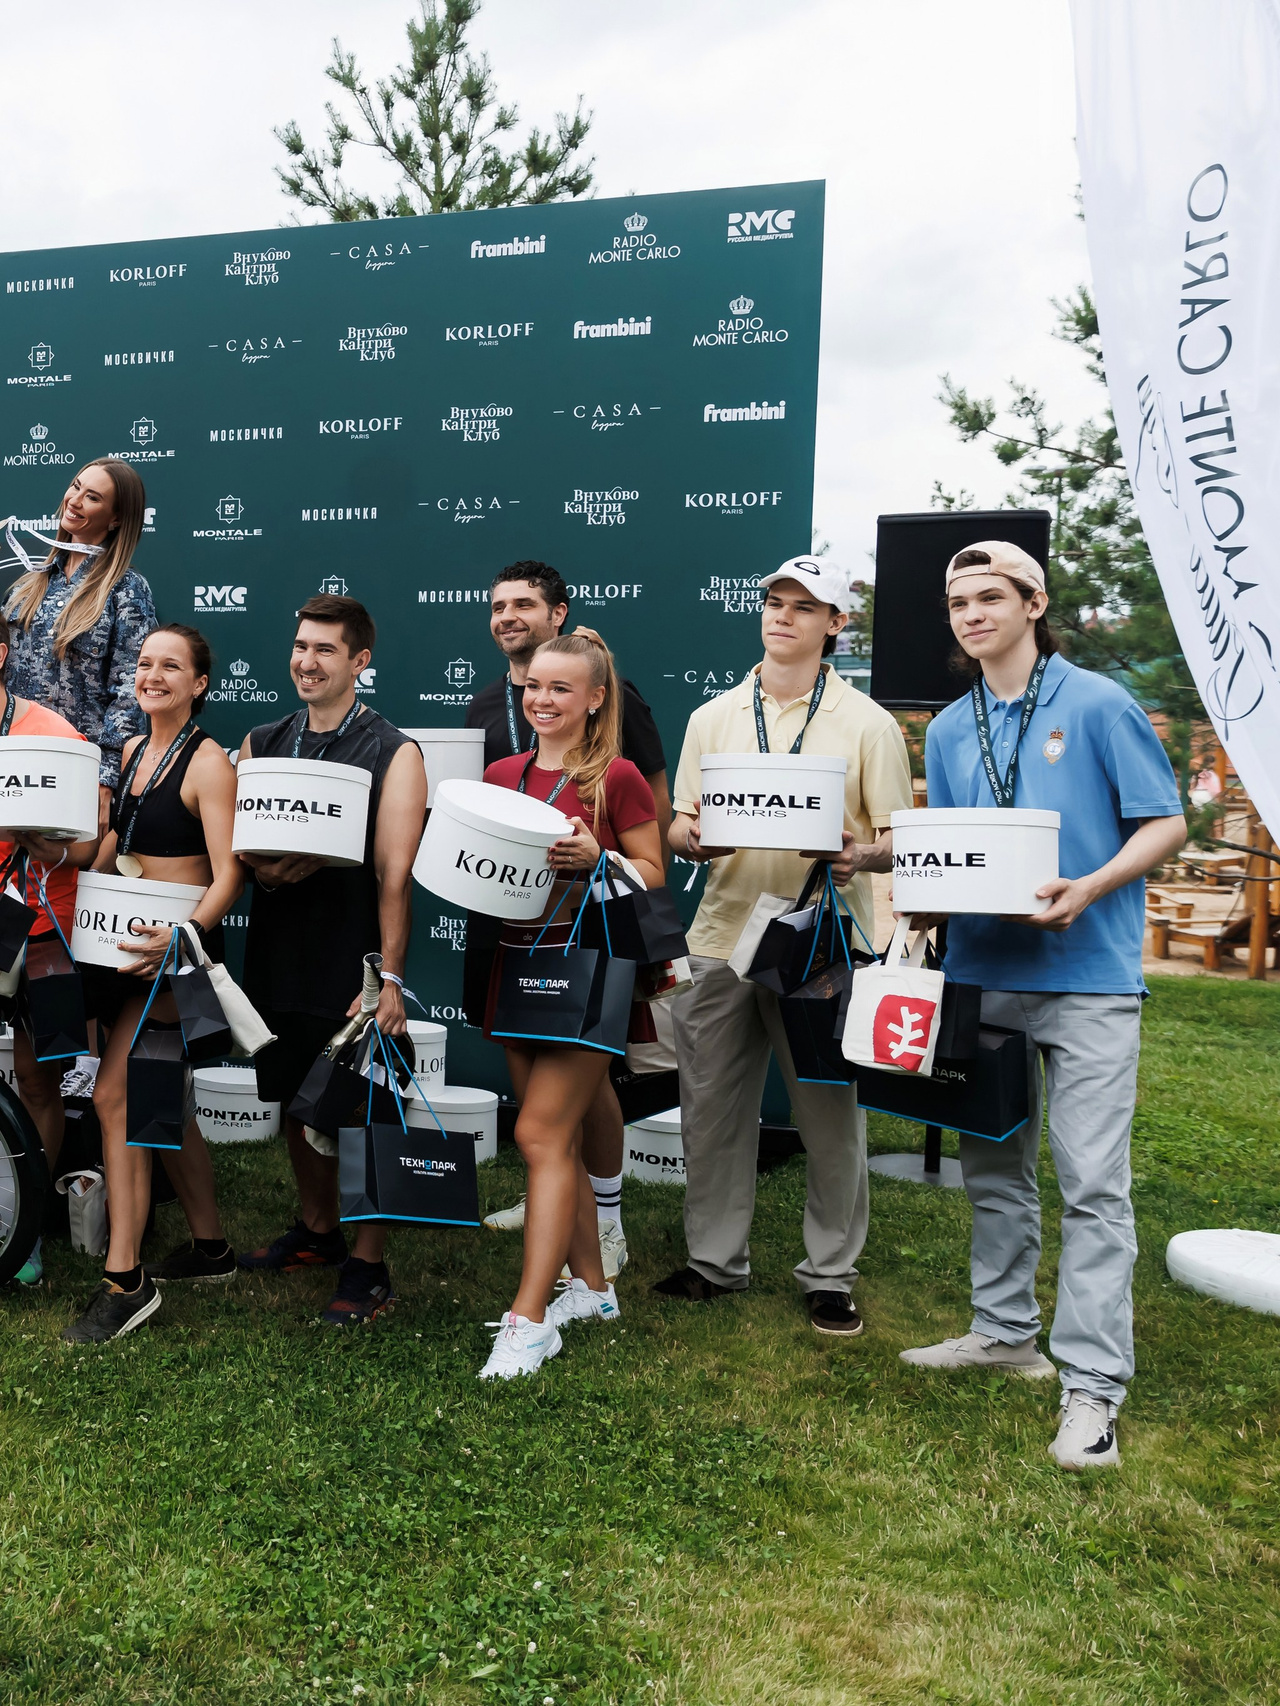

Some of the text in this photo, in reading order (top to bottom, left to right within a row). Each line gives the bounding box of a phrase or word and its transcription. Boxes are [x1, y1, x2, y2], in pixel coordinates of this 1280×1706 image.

[471, 235, 546, 258] frambini
[614, 234, 658, 249] RADIO
[233, 248, 290, 265] Внуково
[349, 243, 411, 258] CASA
[589, 244, 680, 264] MONTE CARLO
[110, 264, 186, 283] KORLOFF
[225, 262, 276, 277] Кантри
[7, 277, 73, 293] МОСКВИЧКА
[245, 273, 279, 286] Клуб
[348, 323, 407, 339] Внуково
[574, 316, 651, 338] frambini
[719, 318, 764, 332] RADIO
[446, 323, 534, 343] KORLOFF
[693, 328, 788, 346] MONTE CARLO
[226, 337, 285, 351] CASA
[339, 337, 392, 351] Кантри
[105, 351, 174, 366] МОСКВИЧКА
[360, 349, 395, 361] Клуб
[7, 374, 72, 384] MONTALE
[451, 403, 513, 420] Внуково
[574, 404, 641, 418] CASA
[704, 401, 785, 422] frambini
[320, 417, 402, 433] KORLOFF
[442, 418, 496, 432] Кантри
[210, 427, 282, 441] МОСКВИЧКА
[463, 430, 500, 443] Клуб
[22, 442, 57, 455] RADIO
[108, 450, 175, 458] MONTALE
[4, 453, 74, 466] MONTE CARLO
[574, 486, 639, 503] Внуково
[686, 492, 782, 507] KORLOFF
[438, 497, 501, 510] CASA
[564, 501, 622, 514] Кантри
[302, 508, 376, 520] МОСКВИЧКА
[587, 513, 625, 526] Клуб
[193, 529, 263, 537] MONTALE
[710, 574, 761, 590] Внуко
[419, 590, 488, 603] МОСКВИЧК
[566, 585, 642, 598] ORLOFF
[700, 588, 761, 601] Кантри
[724, 601, 764, 614] Клуб
[221, 679, 258, 690] RADIO
[246, 691, 278, 702] CARLO
[702, 794, 820, 810] MONTALE
[255, 813, 309, 823] PARIS
[727, 809, 787, 817] PARIS
[892, 853, 985, 868] ONTALE
[456, 849, 556, 889] KORLOF
[504, 890, 531, 899] PARIS
[431, 927, 466, 939] Кант
[519, 978, 569, 988] ТЕХНОПАРК
[214, 1120, 252, 1128] PARIS
[399, 1157, 456, 1171] ТЕХНОПАРК
[630, 1149, 686, 1167] MONT
